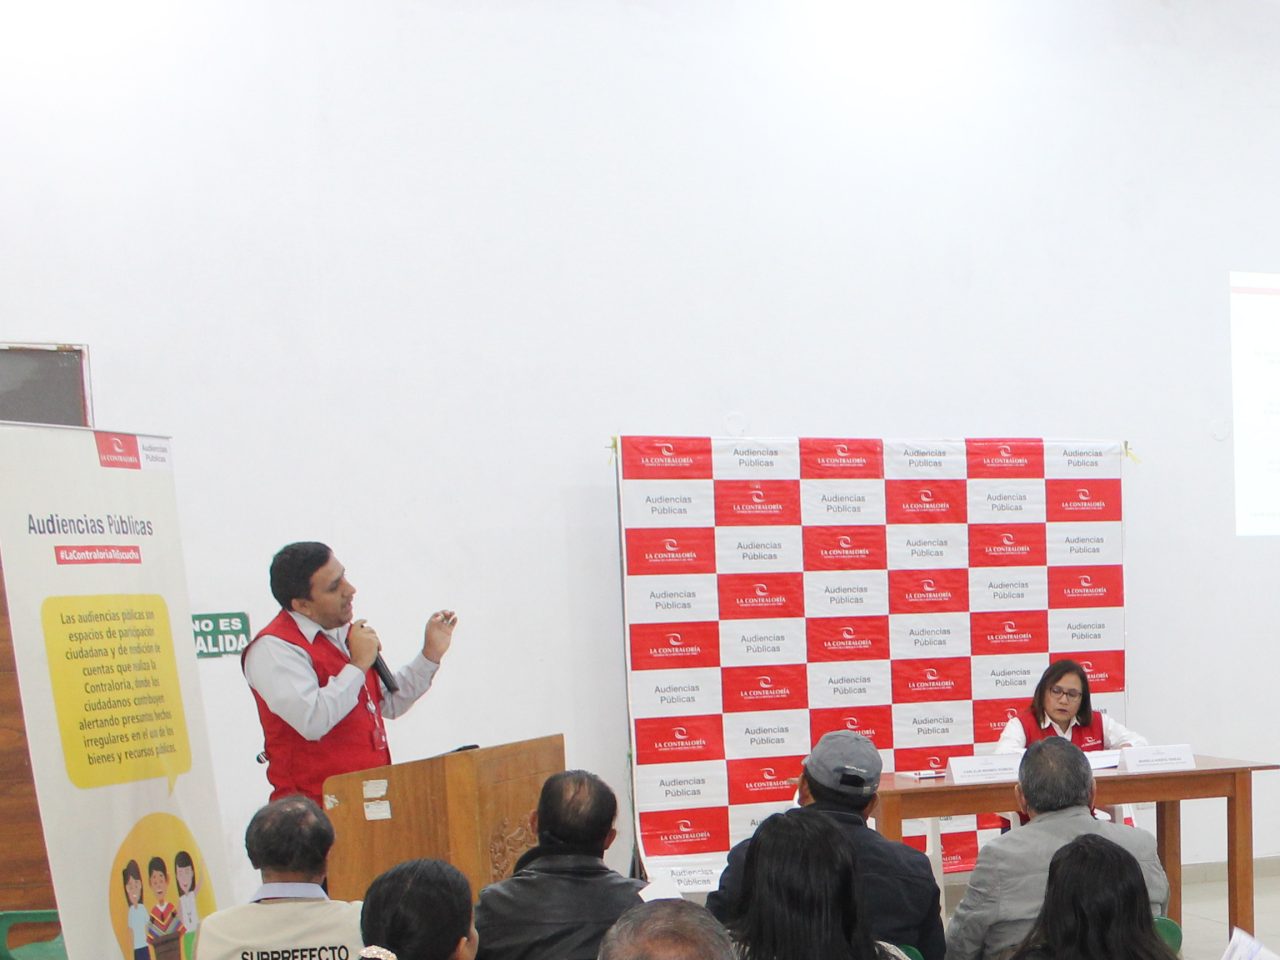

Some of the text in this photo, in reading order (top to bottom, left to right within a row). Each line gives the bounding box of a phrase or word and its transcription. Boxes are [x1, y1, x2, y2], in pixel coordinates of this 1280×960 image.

[733, 448, 778, 457] Audiencias
[903, 448, 946, 457] Audiencias
[1063, 449, 1103, 457] Audiencias
[739, 459, 774, 468] Públicas
[908, 459, 942, 467] Públicas
[1068, 459, 1098, 468] Públicas
[645, 496, 692, 504] Audiencias
[821, 494, 865, 503] Audiencias
[987, 493, 1027, 502] Audiencias
[651, 506, 687, 515] Públicas
[827, 505, 861, 514] Públicas
[992, 503, 1023, 512] Públicas
[28, 514, 153, 535] Audiencias Públicas
[906, 539, 948, 547] Audiencias
[1065, 536, 1104, 545] Audiencias
[736, 541, 782, 550] Audiencias
[911, 549, 943, 558] Públicas
[1069, 546, 1100, 555] Públicas
[742, 552, 777, 561] Públicas
[824, 585, 868, 594] Audiencias
[988, 581, 1029, 589] Audiencias
[650, 591, 696, 599] Audiencias
[993, 591, 1024, 599] Públicas
[830, 596, 864, 604] Públicas
[655, 601, 691, 610] Públicas
[61, 613, 76, 624] Las
[78, 610, 119, 623] audiencias
[220, 618, 242, 630] ES
[1067, 622, 1105, 631] Audiencias
[69, 631, 103, 643] espacios
[106, 628, 116, 638] de
[909, 628, 951, 637] Audiencias
[1072, 632, 1101, 641] Públicas
[741, 634, 785, 643] Audiencias
[914, 638, 946, 647] Públicas
[196, 634, 248, 653] ALIDA
[66, 647, 108, 660] ciudadana
[110, 648, 115, 659] y
[118, 644, 128, 655] de
[746, 644, 780, 653] Públicas
[83, 664, 114, 676] cuentas
[117, 664, 131, 675] que
[990, 668, 1030, 677] Audiencias
[828, 676, 871, 685] Audiencias
[995, 677, 1027, 687] Públicas
[655, 685, 700, 694] Audiencias
[833, 686, 867, 695] Públicas
[660, 695, 695, 705] Públicas
[84, 698, 131, 712] ciudadanos
[80, 715, 119, 730] alertando
[912, 716, 953, 726] Audiencias
[745, 726, 789, 736] Audiencias
[917, 725, 949, 735] Públicas
[84, 733, 129, 748] irregulares
[132, 732, 140, 740] en
[750, 736, 785, 745] Públicas
[88, 753, 115, 765] bienes
[117, 753, 122, 763] y
[659, 777, 706, 787] Audiencias
[665, 787, 701, 797] Públicas
